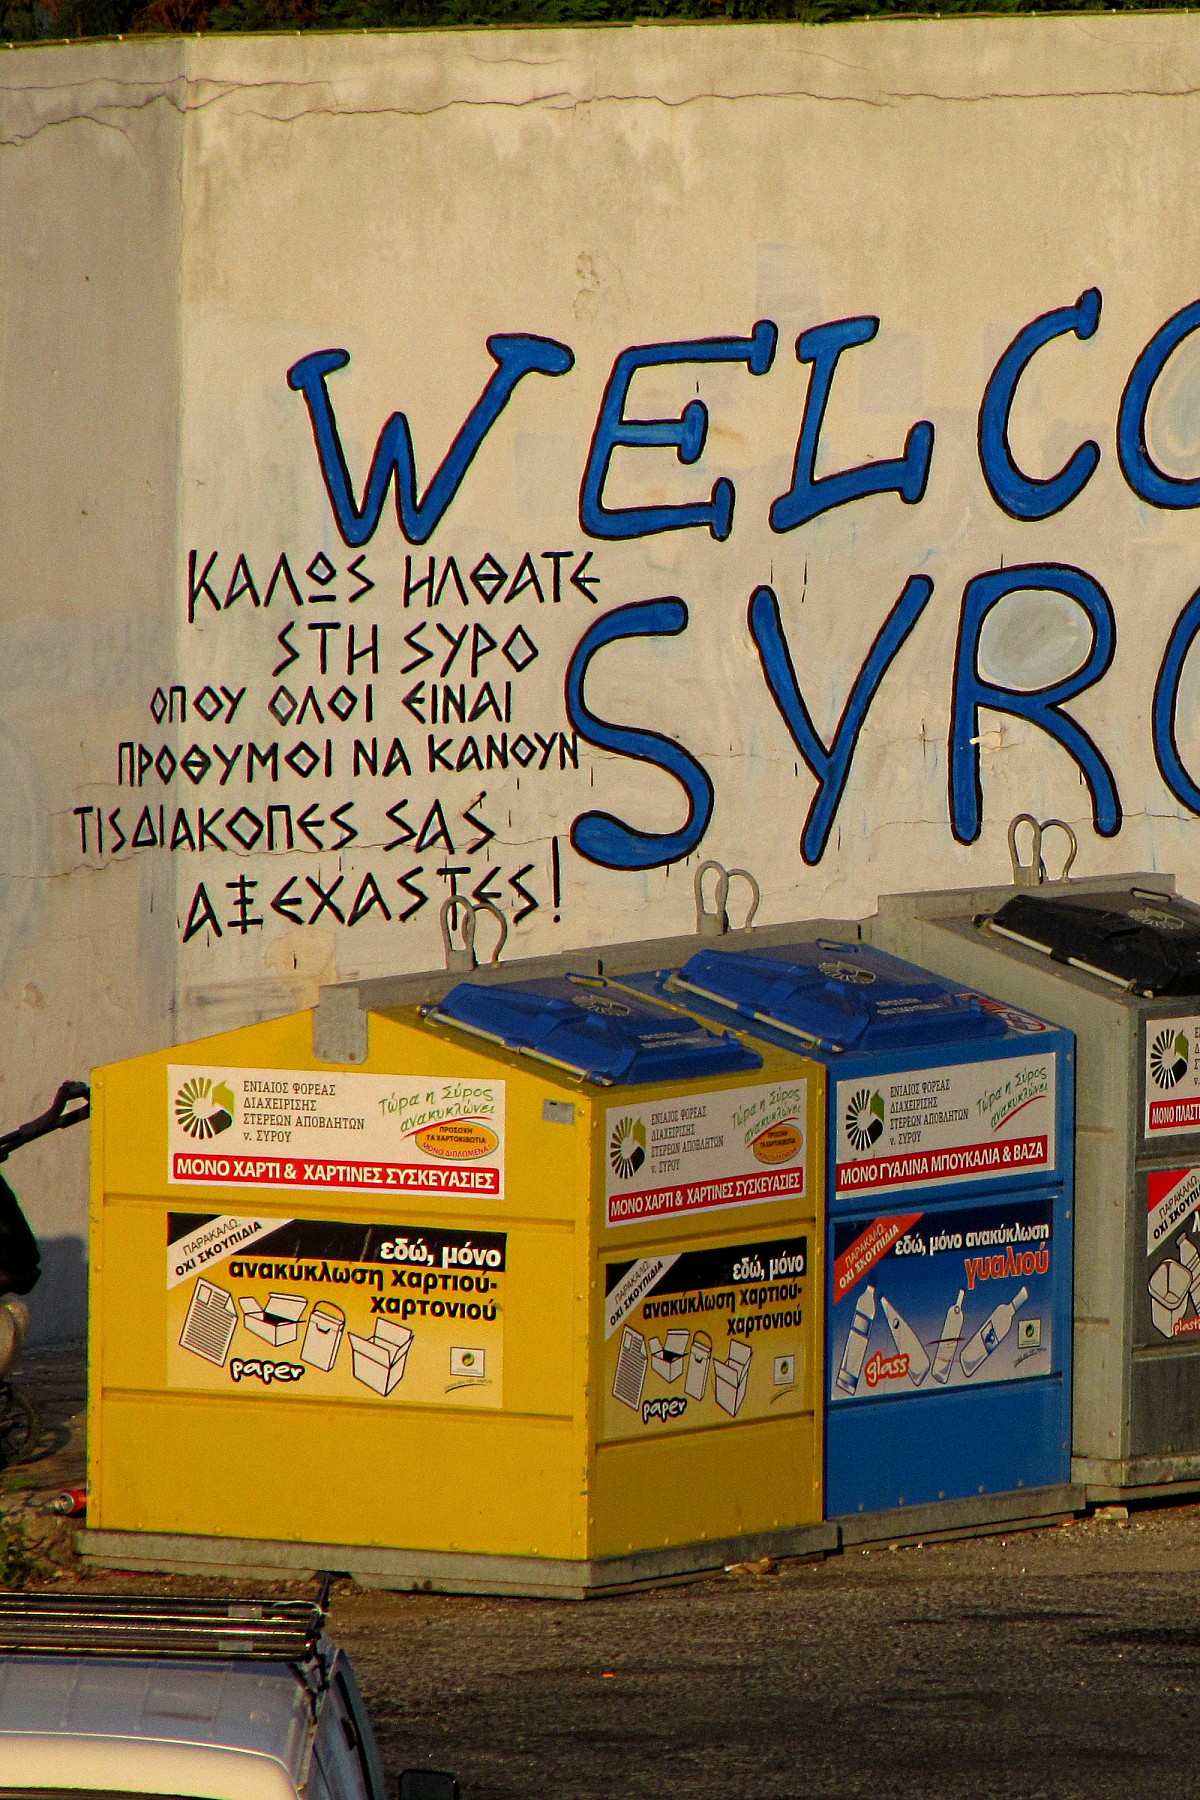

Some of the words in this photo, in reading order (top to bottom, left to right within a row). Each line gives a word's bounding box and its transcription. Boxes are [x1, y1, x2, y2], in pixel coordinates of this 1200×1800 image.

[243, 1080, 289, 1094] ΕΝΙΑΙΟΣ
[292, 1083, 336, 1096] ΦΟΡΕΑΣ
[890, 1082, 920, 1098] ΕΝΙΑΙΟΣ
[921, 1078, 950, 1095] ΦΟΡΕΑΣ
[1015, 1065, 1048, 1088] Σύρος
[243, 1097, 317, 1111] ΔΙΑΧΕΙΡΙΣΗΣ
[379, 1092, 419, 1116] Τώρα
[426, 1091, 435, 1104] η
[442, 1083, 494, 1101] Σύρος
[243, 1113, 291, 1126] ΣΤΕΡΕΩΝ
[295, 1115, 365, 1130] ΑΠΟΒΛΗΤΩΝ
[400, 1100, 495, 1133] ανακυκλώνει
[1152, 1107, 1175, 1125] ΜΟΝΟ
[256, 1130, 291, 1142] ΣΥΡΟΥ
[898, 1130, 922, 1145] ΣΥΡΟΥ
[177, 1158, 230, 1176] ΜΟΝΟ
[233, 1161, 280, 1179] ΧΑΡΤΙ
[284, 1164, 297, 1180] &
[303, 1164, 383, 1184] ΧΑΡΤΙΝΕΣ
[386, 1168, 495, 1189] ΣΥΣΚΕΥΑΣΙΕΣ
[840, 1164, 878, 1186] ΜΟΝΟ
[879, 1158, 929, 1180] ΓΥΑΛΙΝΑ
[931, 1147, 1001, 1173] ΜΠΟΥΚΑΛΙΑ
[1002, 1147, 1012, 1162] &
[1013, 1141, 1044, 1161] ΒΑΖΑ
[610, 1199, 643, 1217] ΜΟΝΟ
[645, 1195, 674, 1212] ΧΑΡΤΙ
[675, 1192, 684, 1205] &
[686, 1182, 734, 1205] ΧΑΡΤΙΝΕΣ
[735, 1172, 801, 1197] ΣΥΣΚΕΥΑΣΙΕΣ
[894, 1233, 927, 1257] εδώ,
[929, 1229, 962, 1257] μόνο
[965, 1222, 1049, 1248] ανακύκλωση
[1153, 1220, 1169, 1240] ΟΧΙ
[175, 1258, 196, 1276] ΟΧΙ
[197, 1221, 262, 1263] ΣΚΟΥΠΙΔΙΑ
[380, 1236, 435, 1266] εδώ,
[442, 1240, 502, 1269] μόνο
[839, 1268, 855, 1289] ΟΧΙ
[855, 1224, 900, 1273] ΣΚΟΥΠΙΔΙΑ
[229, 1257, 384, 1291] ανακύκλωση
[390, 1266, 498, 1295] χαρτιού-
[732, 1254, 765, 1282] εδώ,
[769, 1250, 804, 1281] μόνο
[964, 1242, 1049, 1290] γυαλιού
[610, 1306, 624, 1326] ΟΧΙ
[624, 1260, 664, 1310] ΣΚΟΥΠΙΔΙΑ
[642, 1290, 736, 1320] ανακύκλωση
[369, 1296, 498, 1322] χαρτονιού
[727, 1304, 802, 1338] χαρτονιού
[231, 1359, 303, 1384] paper
[866, 1353, 909, 1384] glass
[643, 1398, 687, 1423] paper
